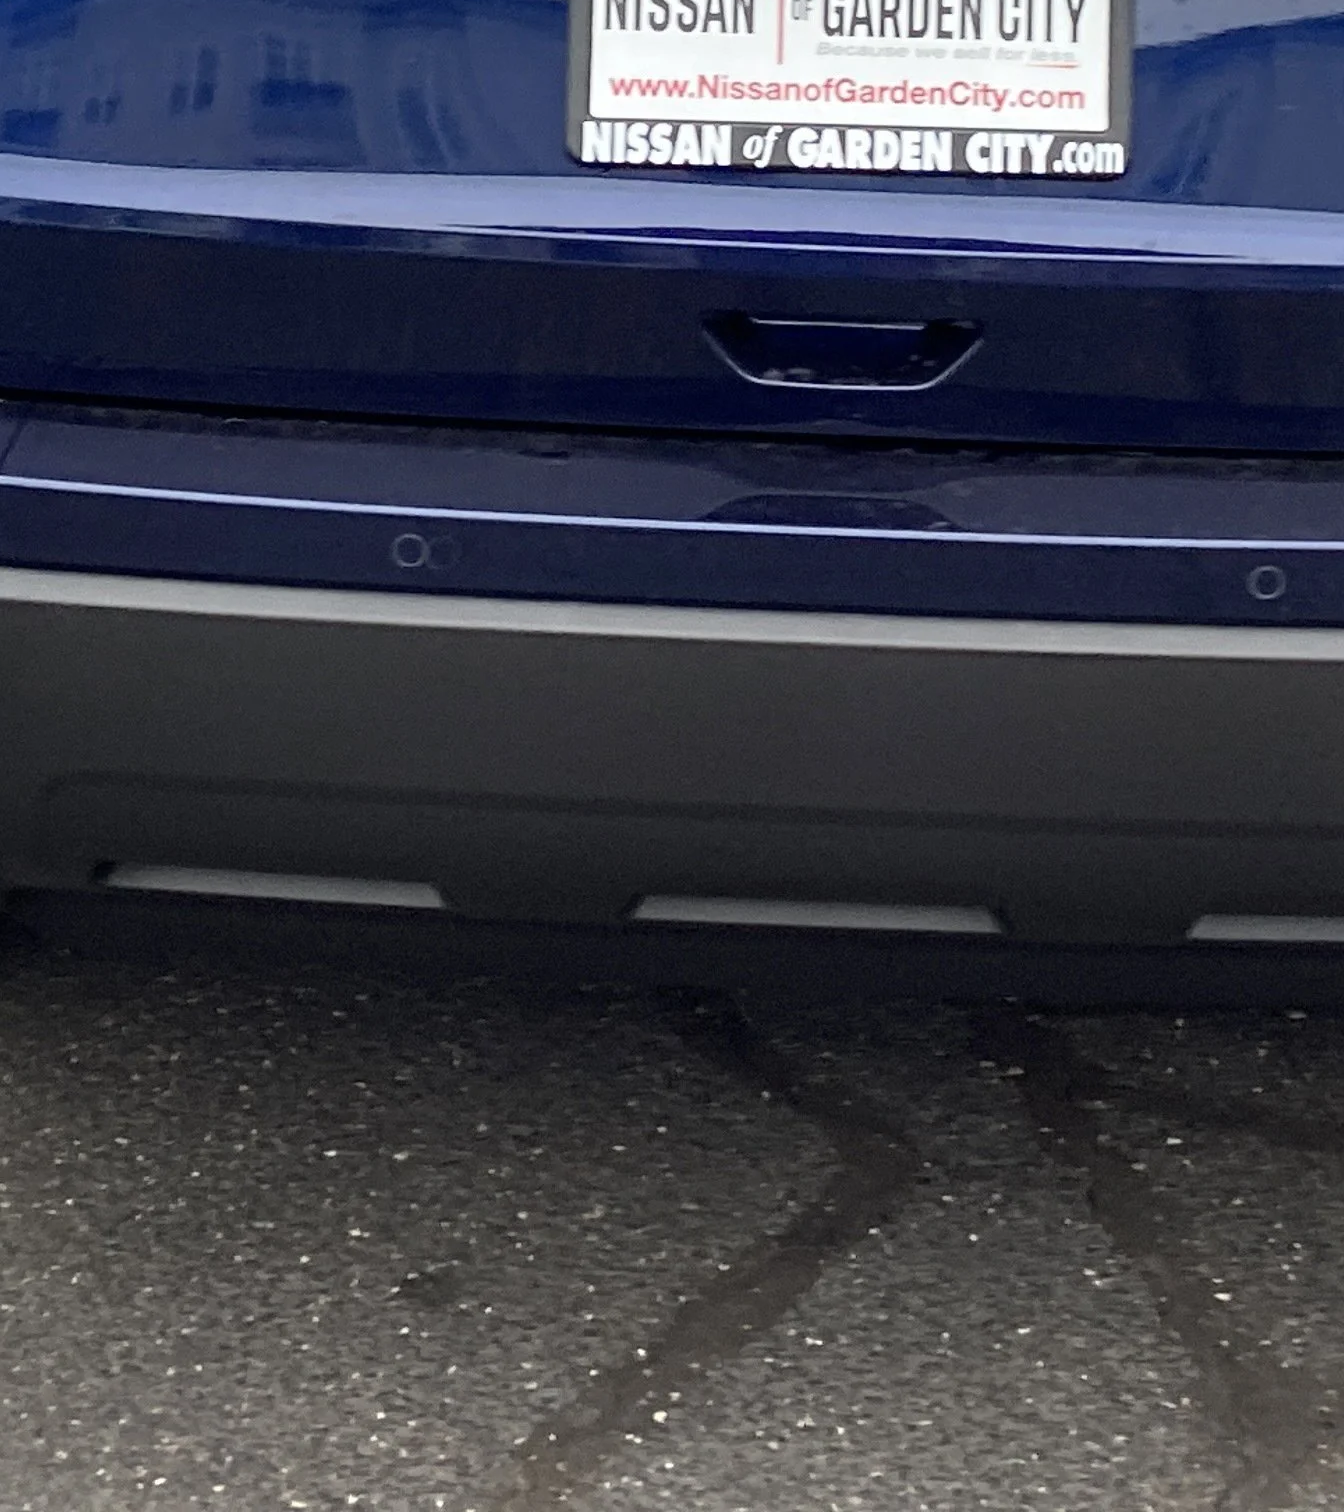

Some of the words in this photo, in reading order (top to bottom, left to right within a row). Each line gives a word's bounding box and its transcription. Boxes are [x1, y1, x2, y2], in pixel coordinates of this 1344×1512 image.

[609, 74, 1086, 112] www.NissanofGardenCity.com
[581, 120, 732, 167] NISSAN
[742, 125, 783, 168] of
[787, 126, 952, 172] GARDEN
[965, 131, 1125, 175] CITY.com
